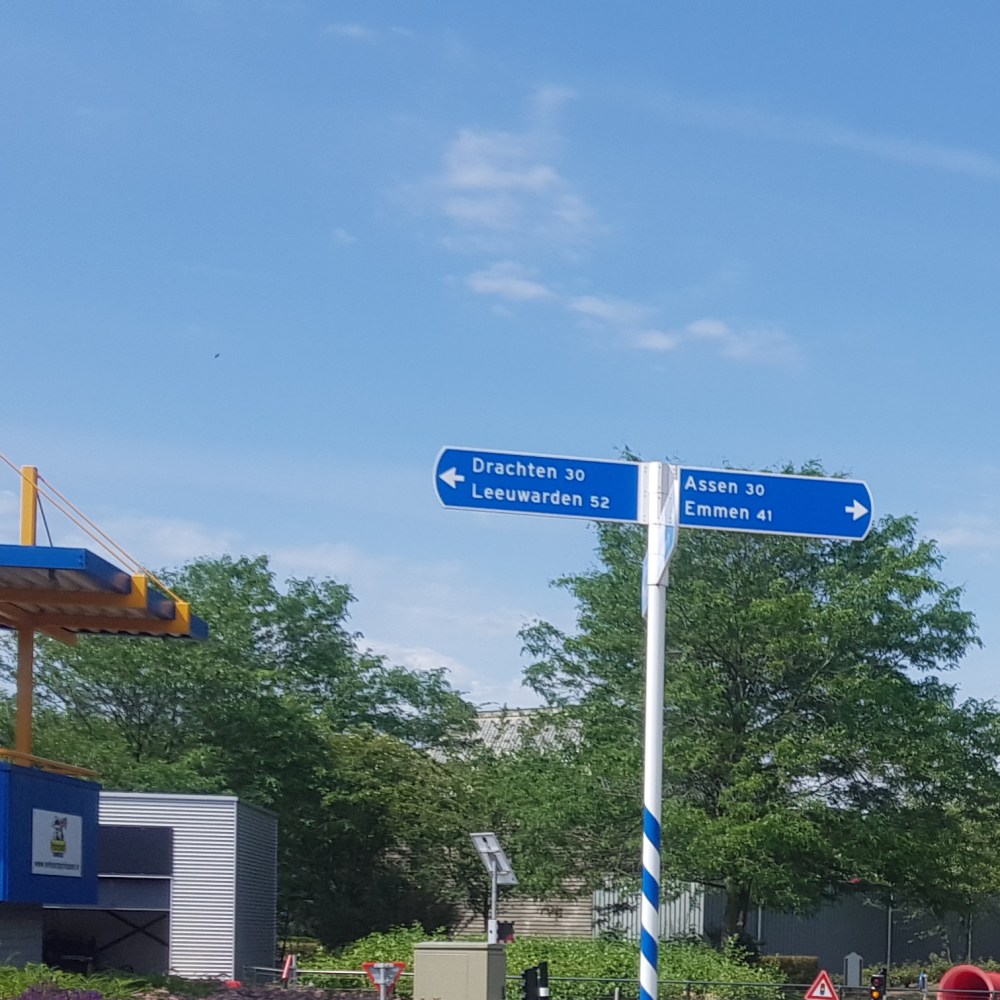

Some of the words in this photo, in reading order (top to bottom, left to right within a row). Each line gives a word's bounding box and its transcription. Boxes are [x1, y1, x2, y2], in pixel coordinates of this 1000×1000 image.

[472, 457, 557, 479] Drachten
[565, 468, 585, 482] 30
[472, 483, 583, 507] Leeuwarden
[590, 495, 610, 509] 52
[684, 475, 738, 494] Assen
[745, 483, 765, 496] 30
[685, 500, 749, 520] Emmen
[756, 509, 773, 522] 41
